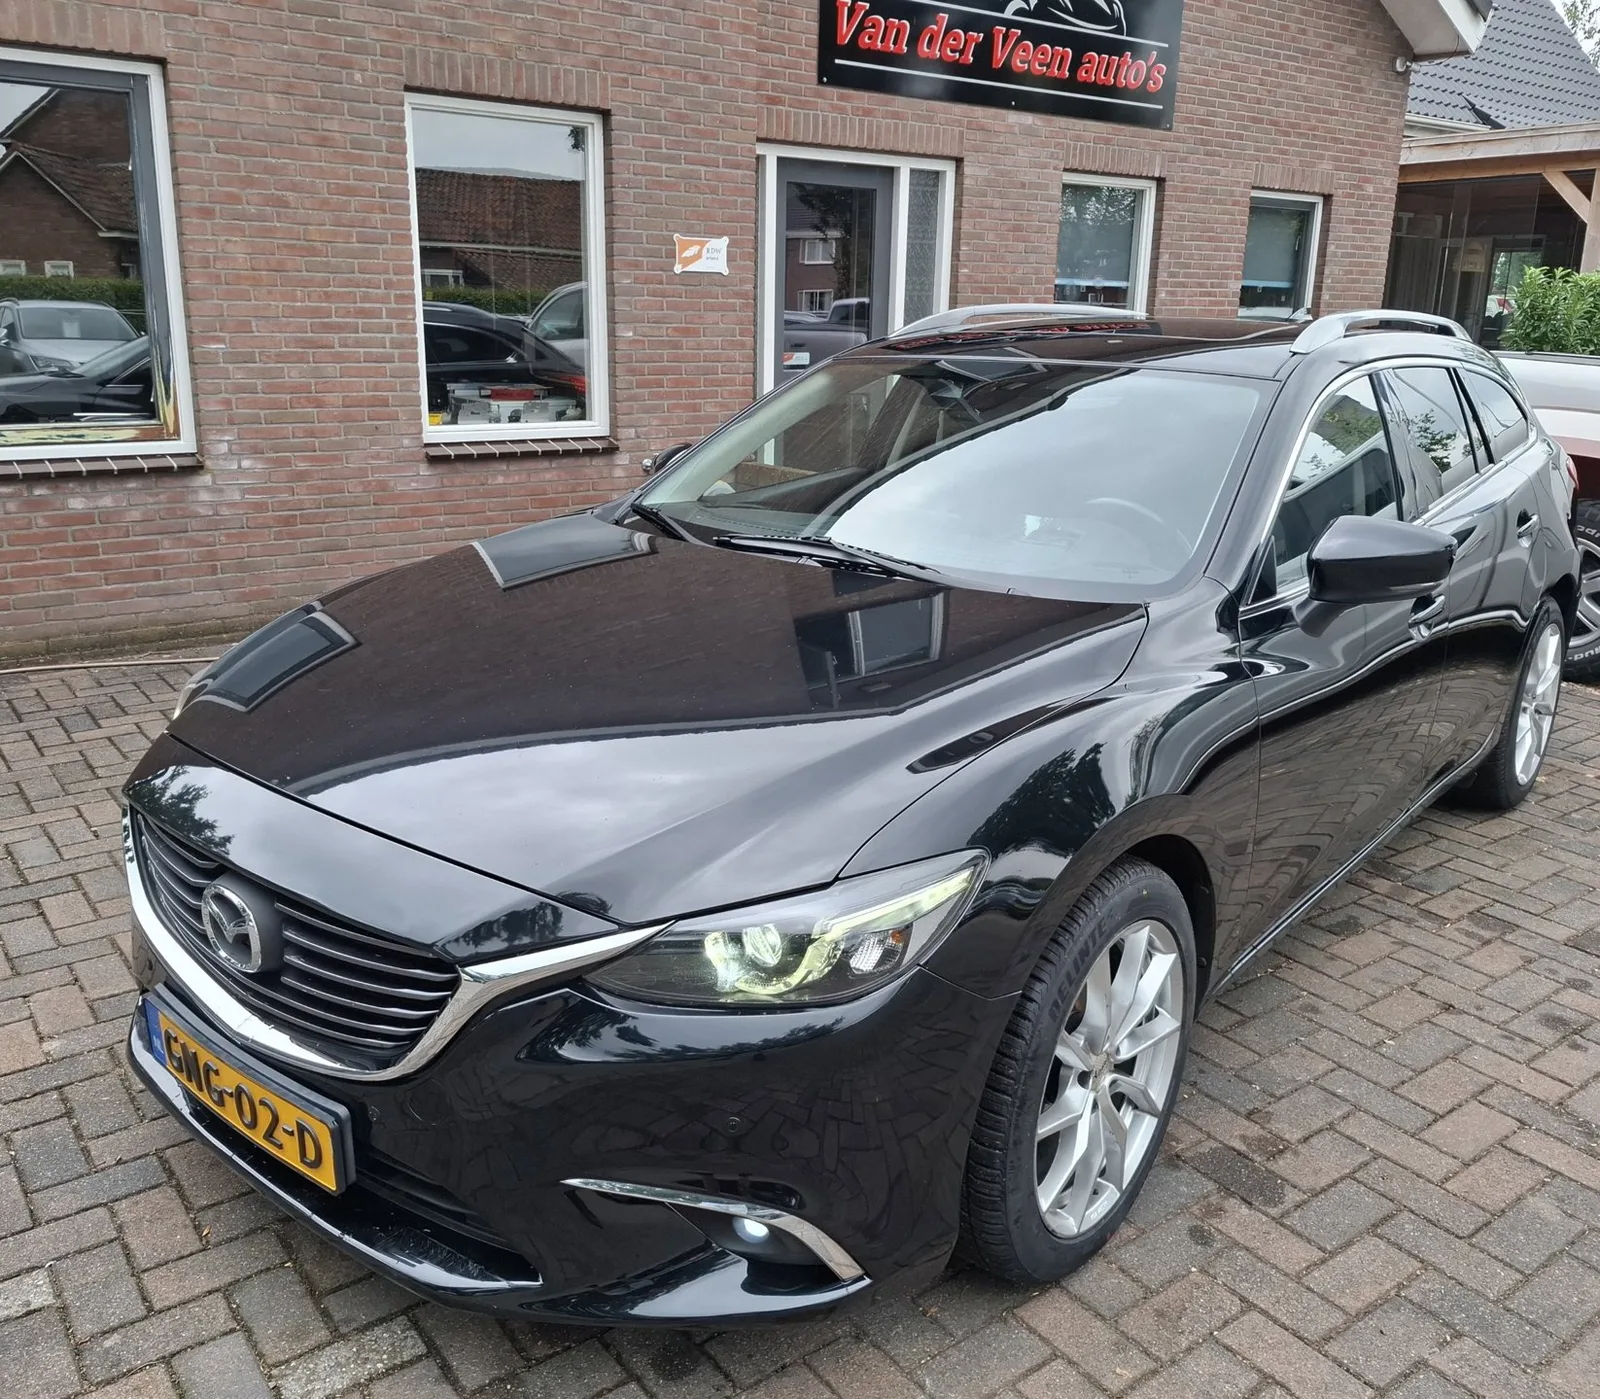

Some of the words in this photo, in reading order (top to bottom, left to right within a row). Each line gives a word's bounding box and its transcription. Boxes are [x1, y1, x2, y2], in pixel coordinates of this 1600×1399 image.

[836, 1, 910, 55] Van
[918, 13, 982, 66] der
[991, 26, 1073, 79] Veen
[1077, 51, 1167, 93] auto's
[164, 1028, 323, 1169] GNG-02-D
